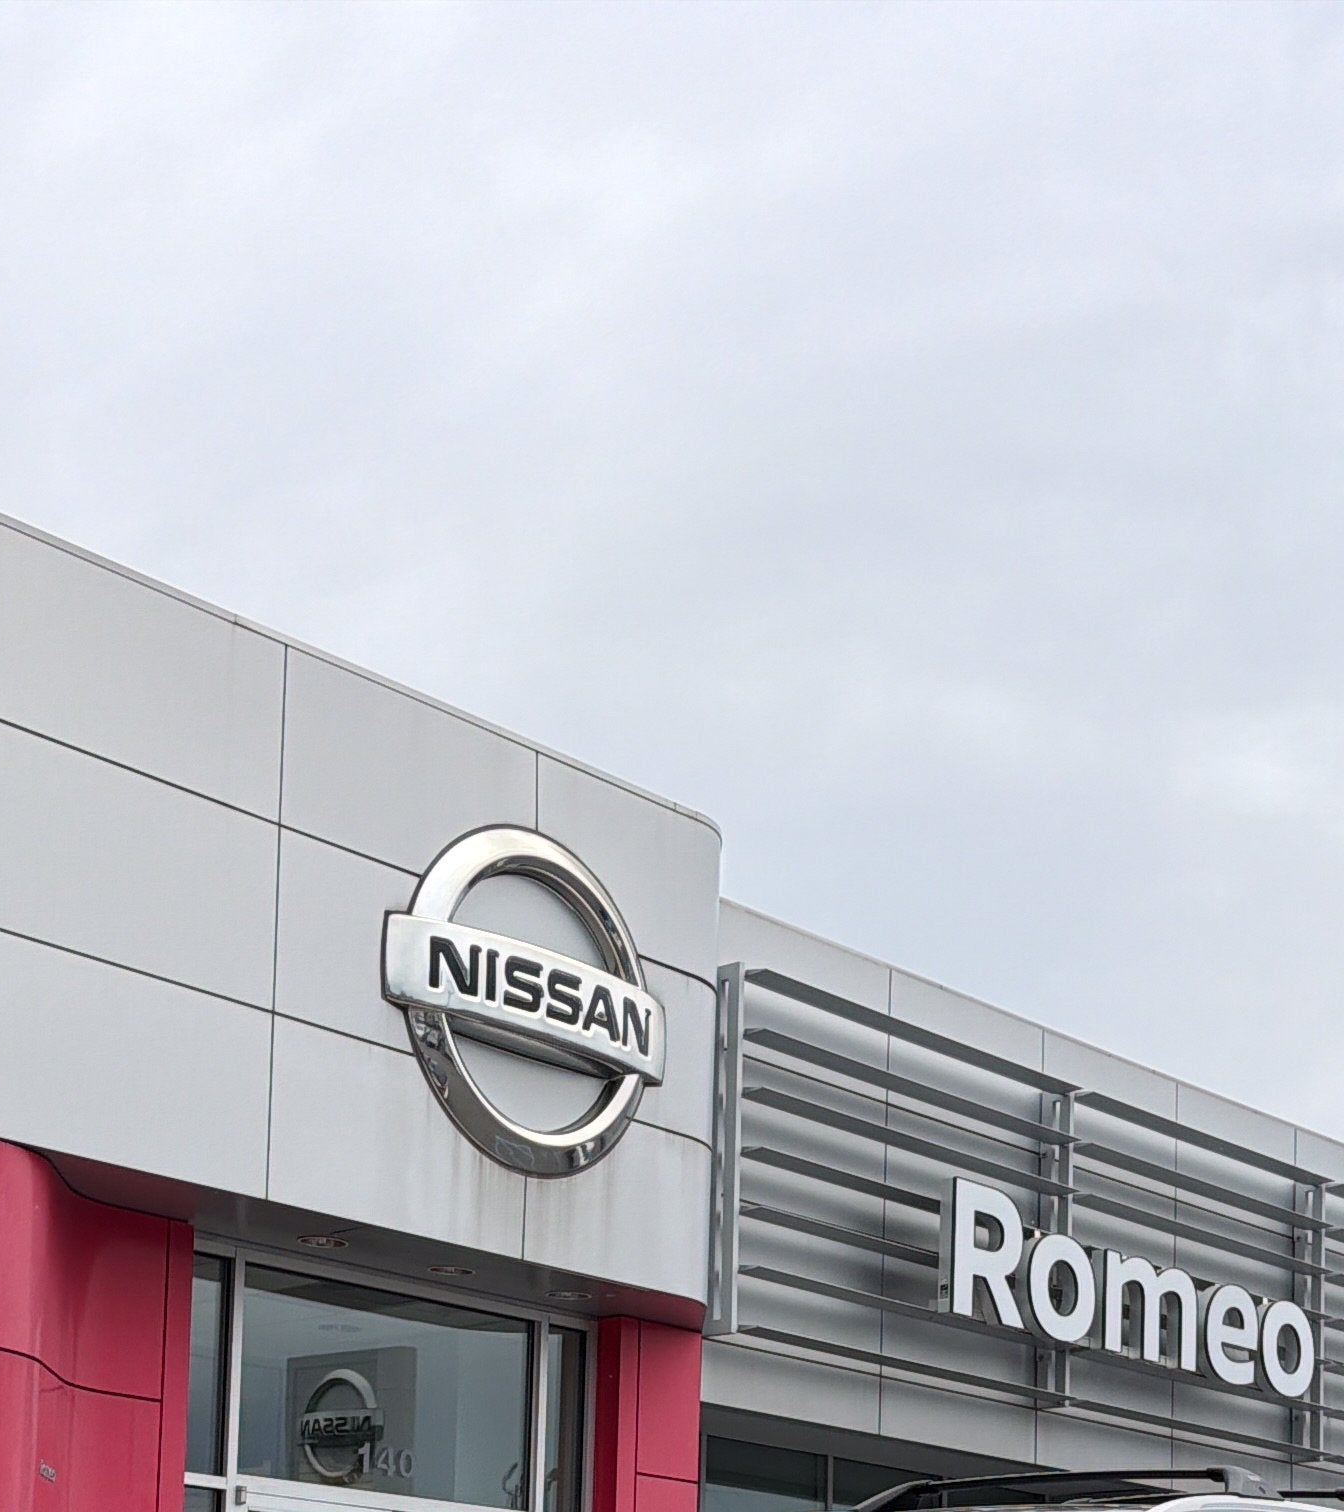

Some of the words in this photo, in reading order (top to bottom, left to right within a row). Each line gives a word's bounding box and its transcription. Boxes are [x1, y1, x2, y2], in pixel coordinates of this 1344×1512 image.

[428, 935, 651, 1057] NISSAN
[951, 1176, 1315, 1398] Romeo
[358, 1442, 415, 1479] 140
